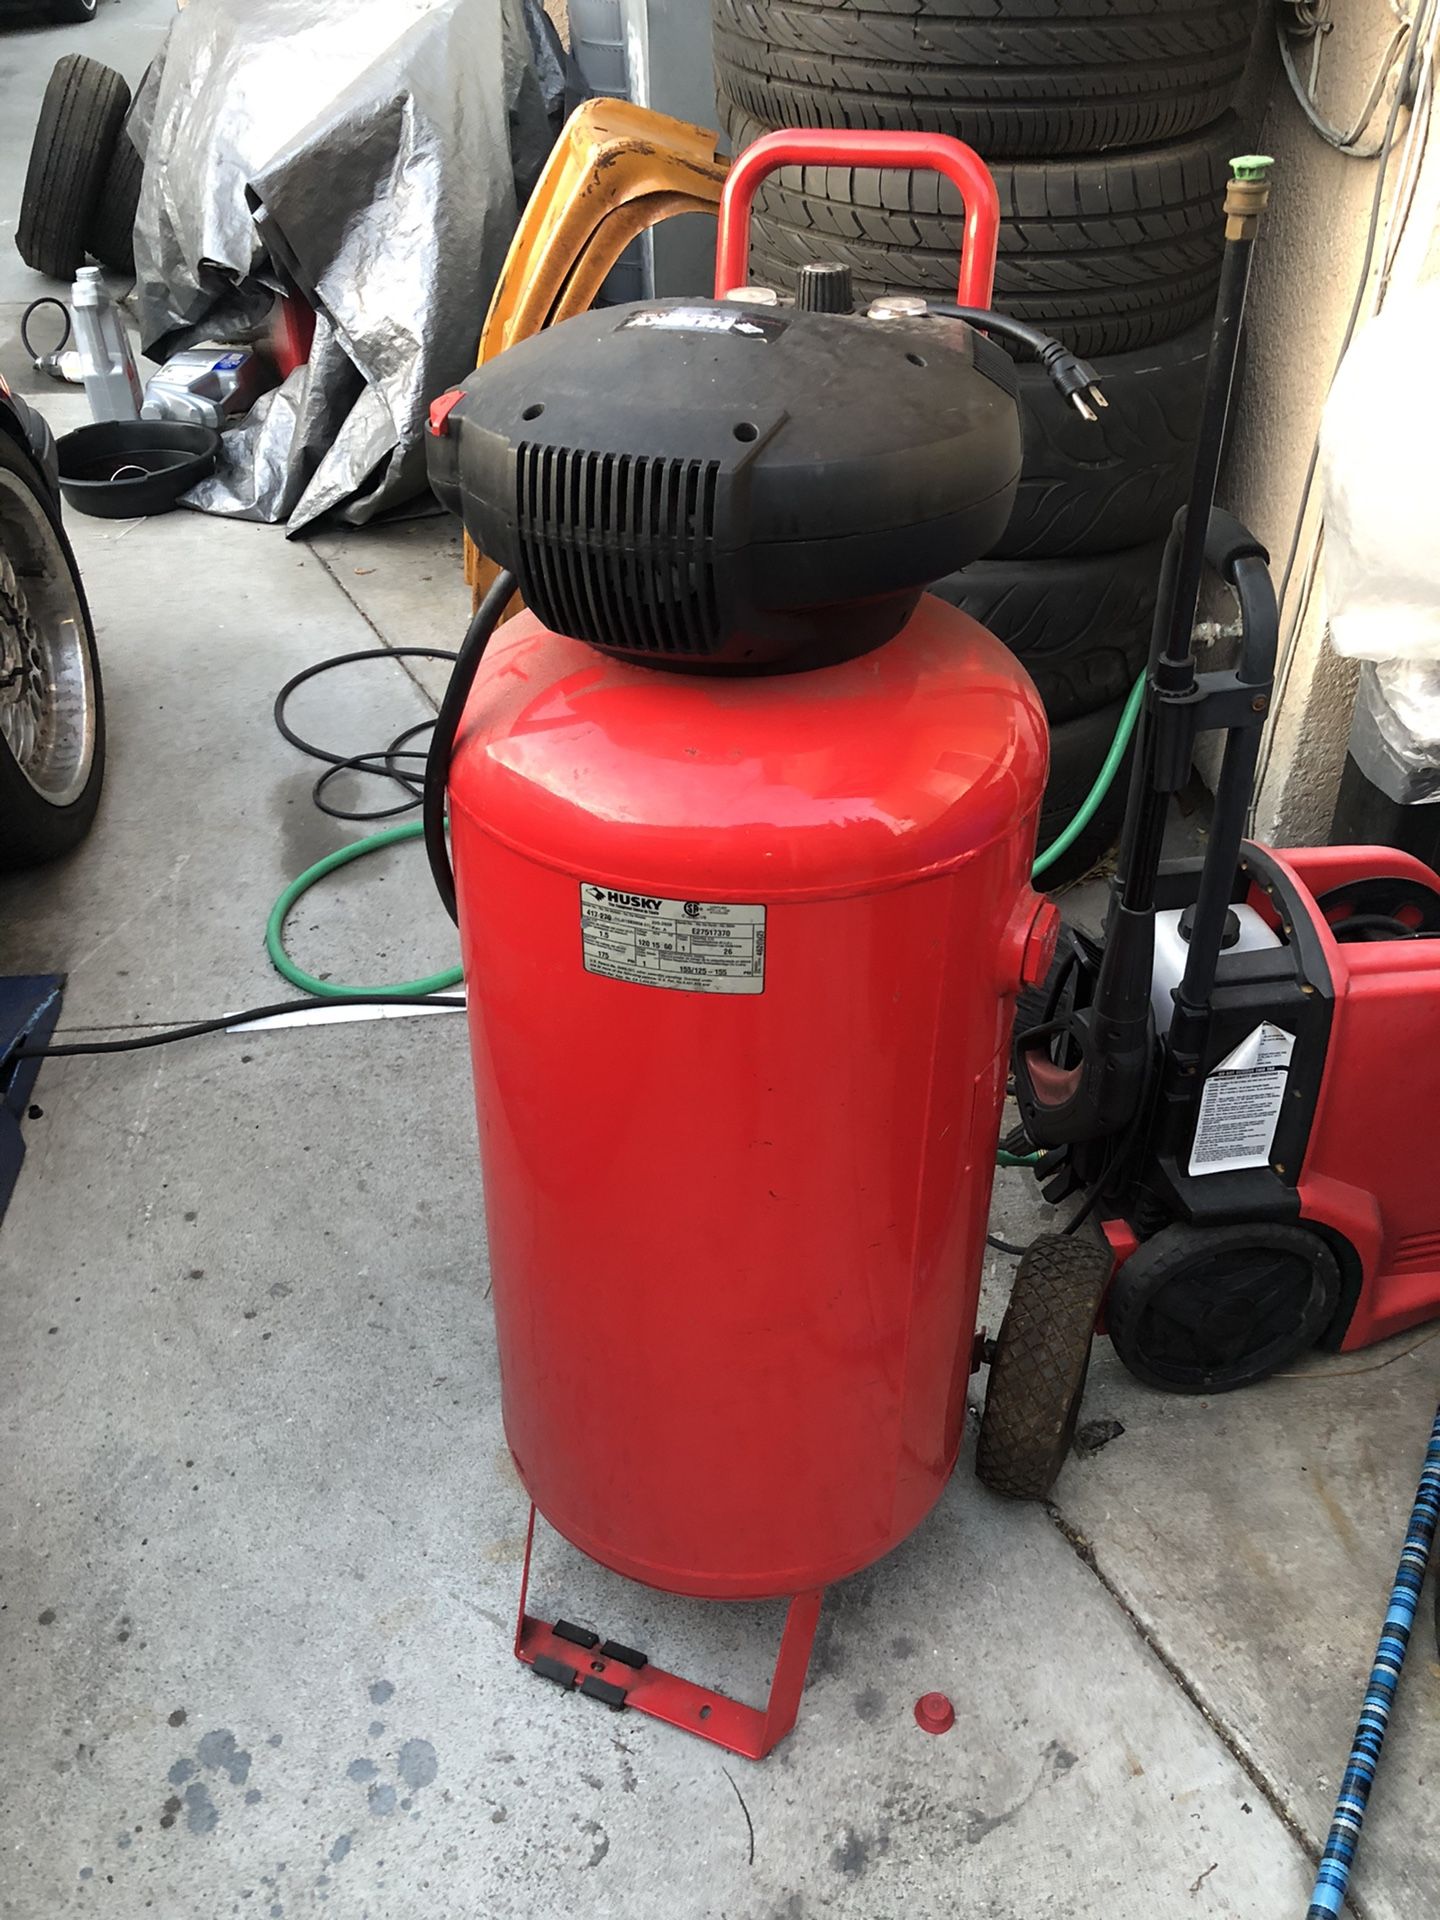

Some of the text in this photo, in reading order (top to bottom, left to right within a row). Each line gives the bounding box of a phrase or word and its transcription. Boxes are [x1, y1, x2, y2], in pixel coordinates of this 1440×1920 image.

[607, 891, 663, 910] HUSKY
[638, 939, 650, 947] 120
[652, 941, 660, 949] 15
[597, 950, 609, 960] 175
